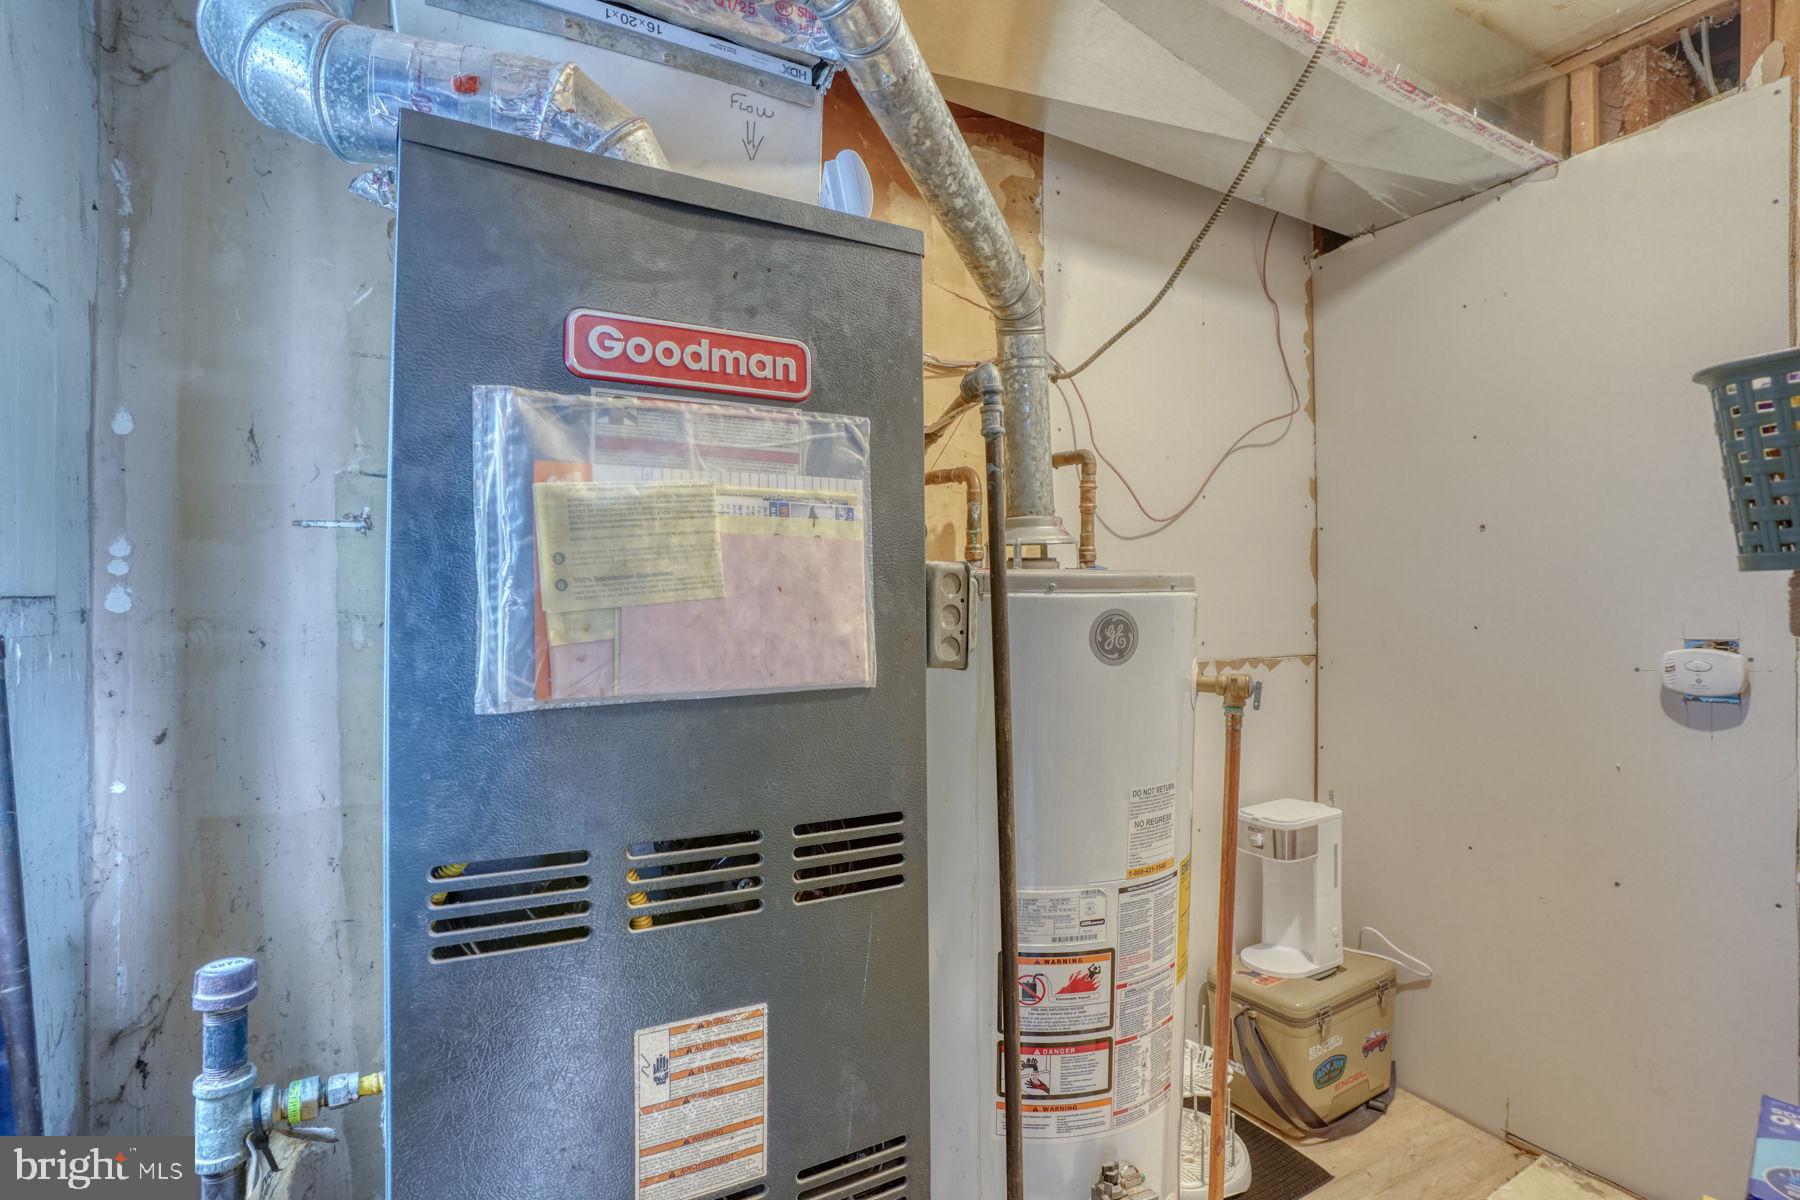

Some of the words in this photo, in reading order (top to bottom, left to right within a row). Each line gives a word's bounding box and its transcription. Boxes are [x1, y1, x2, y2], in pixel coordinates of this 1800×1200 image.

[782, 63, 807, 81] HDX
[587, 324, 798, 383] Goodman
[1132, 789, 1142, 798] DO
[1143, 786, 1155, 796] NOT
[1156, 782, 1175, 793] RETURN
[1134, 819, 1145, 828] NO
[1043, 957, 1084, 965] WARNING
[1042, 1047, 1076, 1055] DANGER
[1334, 1072, 1368, 1092] ENGEL
[692, 1128, 724, 1141] WARNING
